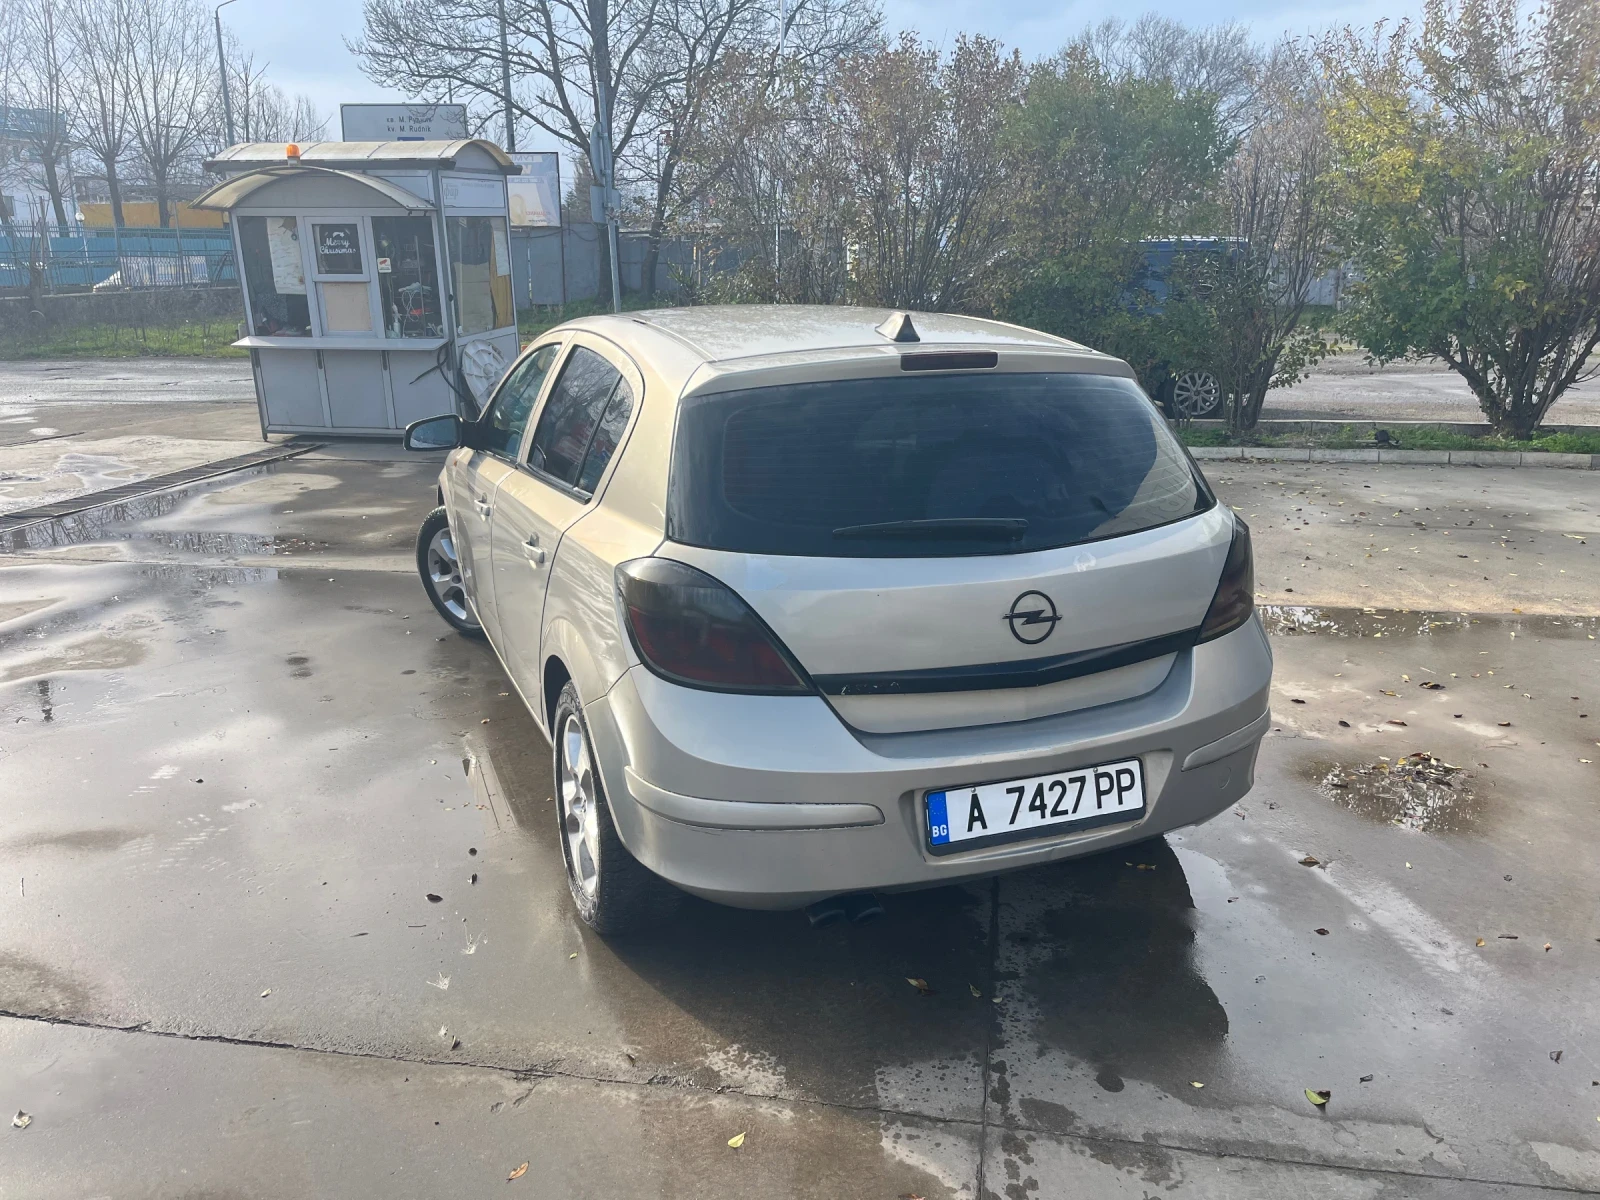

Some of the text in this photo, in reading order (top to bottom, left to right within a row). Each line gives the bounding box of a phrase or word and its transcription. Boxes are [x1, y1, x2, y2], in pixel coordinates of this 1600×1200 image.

[324, 238, 350, 248] Merry
[320, 246, 356, 254] Christmas
[967, 768, 1136, 832] A 7427 PP
[932, 825, 948, 837] BG
